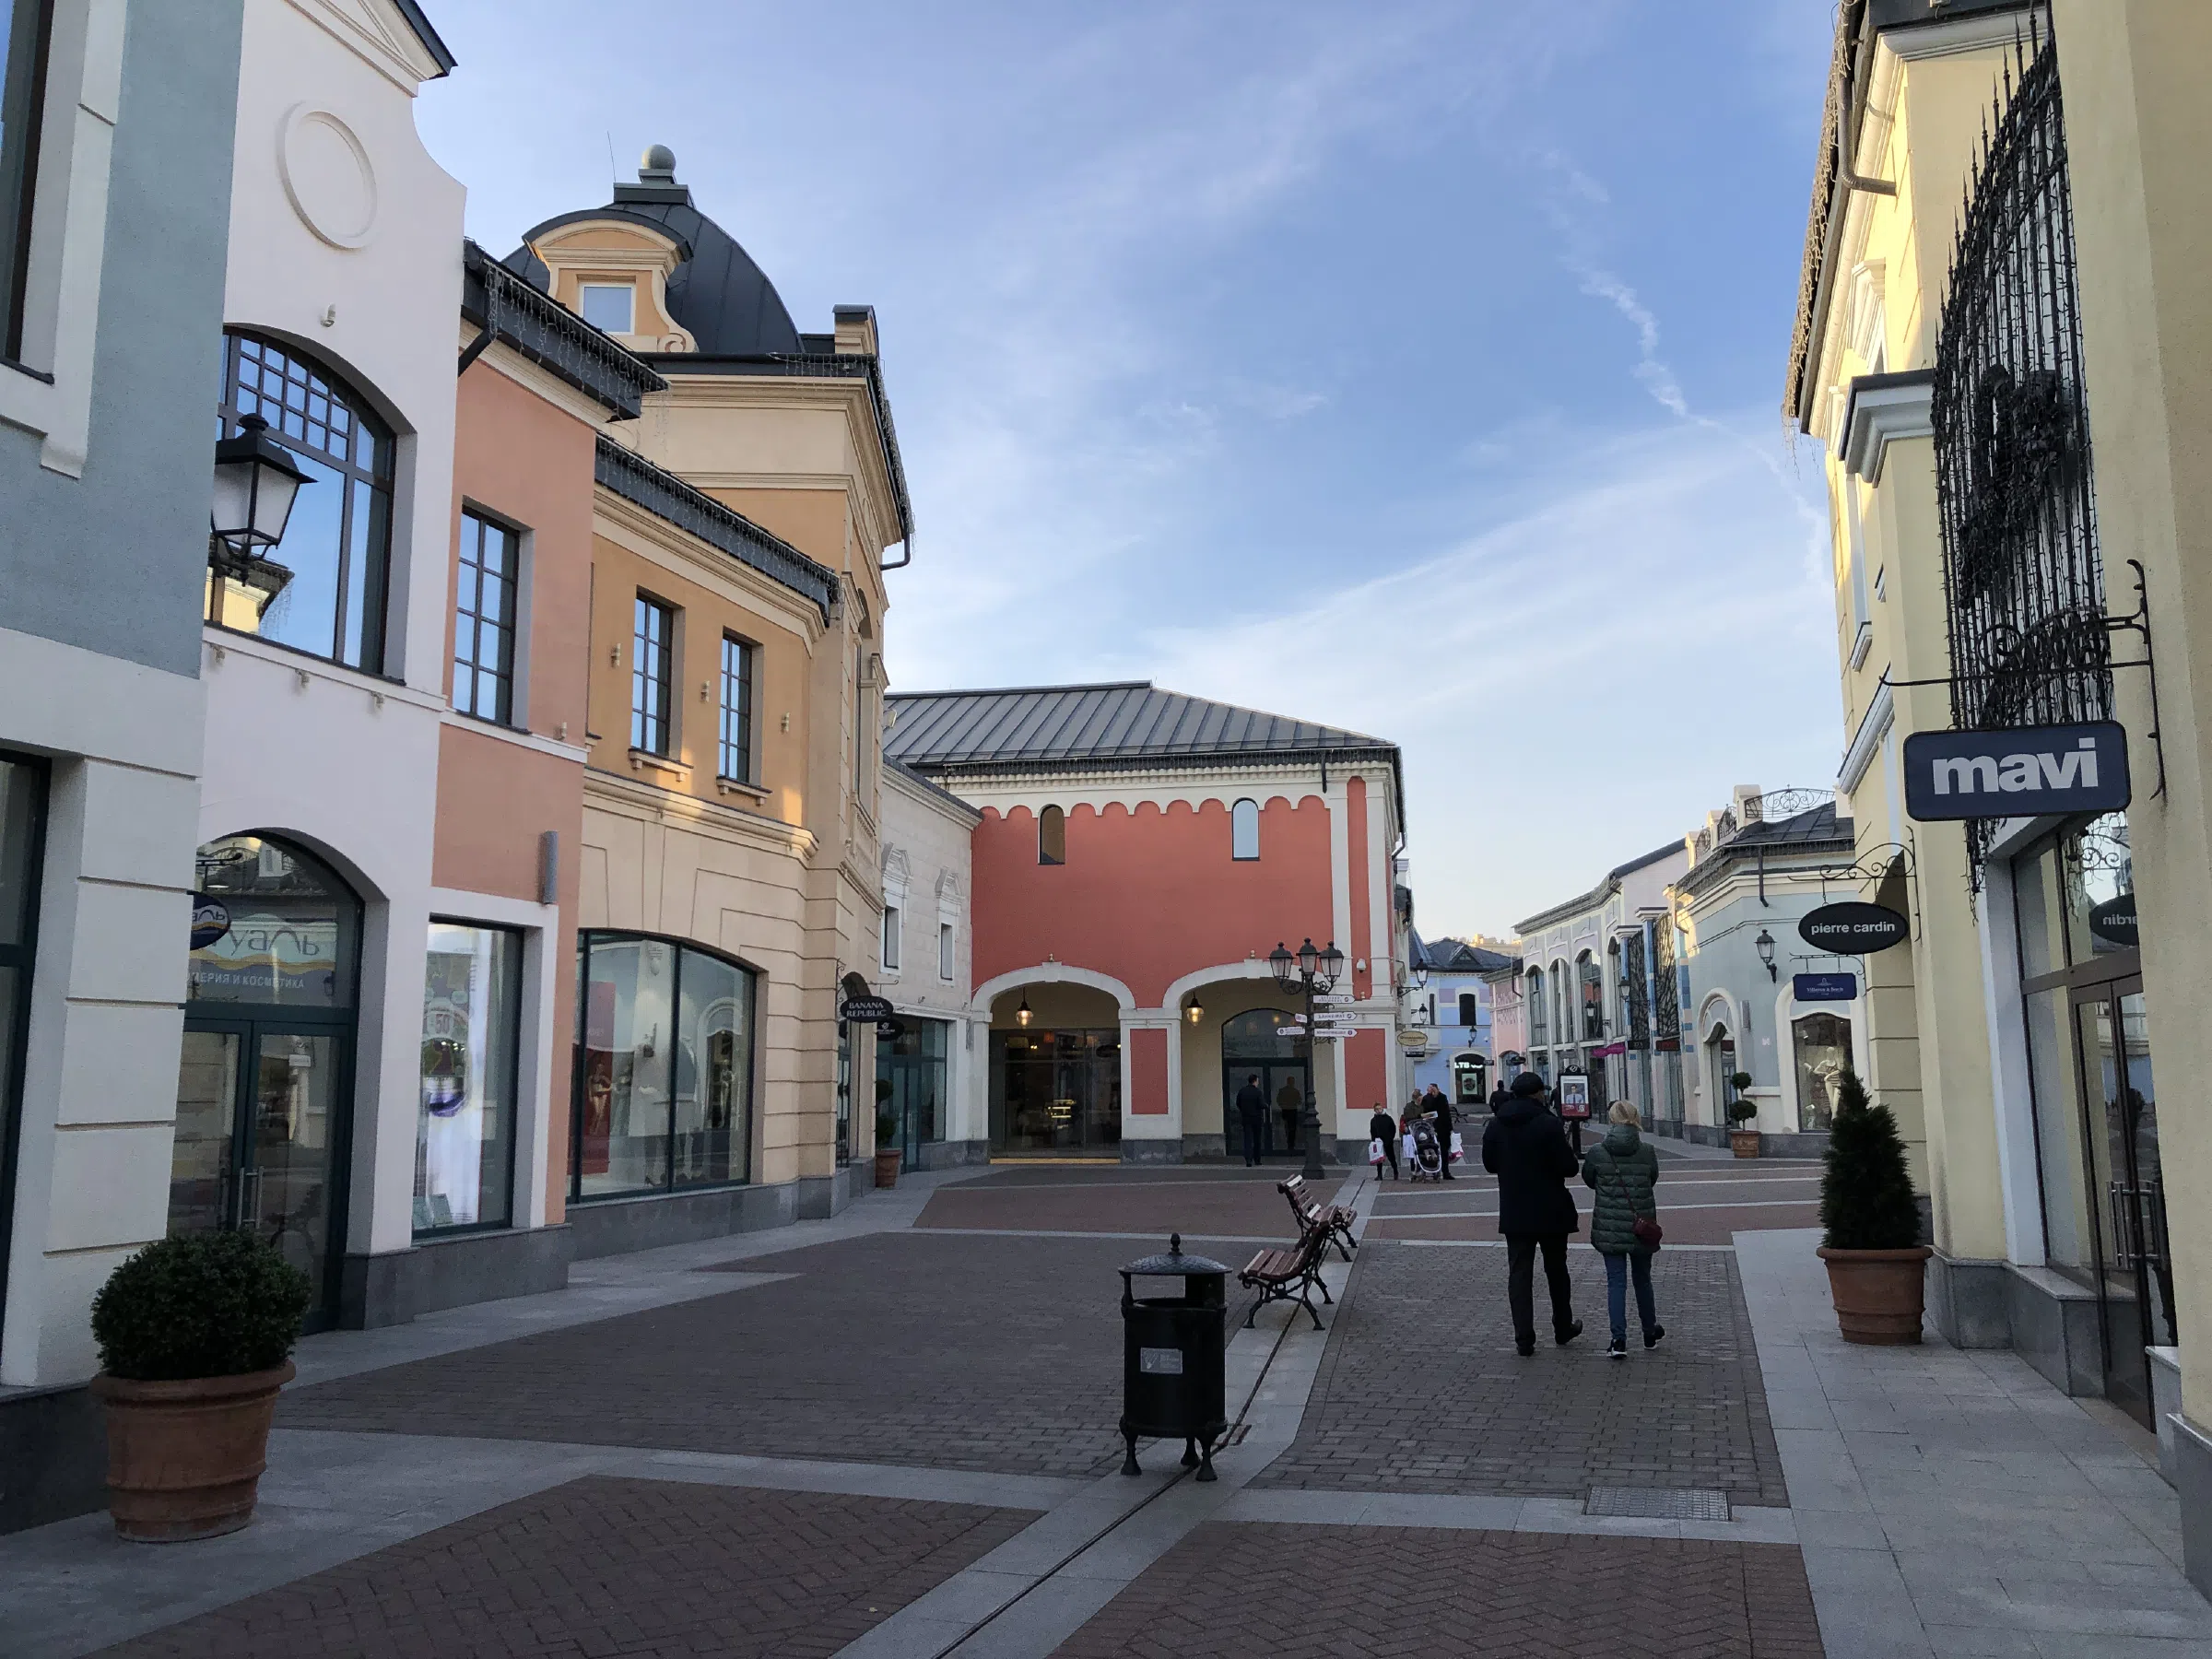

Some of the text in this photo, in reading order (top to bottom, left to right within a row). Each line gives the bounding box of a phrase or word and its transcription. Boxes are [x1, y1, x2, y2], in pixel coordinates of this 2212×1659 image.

[1932, 737, 2099, 794] mavi
[1811, 921, 1896, 935] pierre cardin
[213, 927, 320, 956] уаль
[232, 974, 240, 984] И
[241, 975, 304, 989] КОСМЕТИКА
